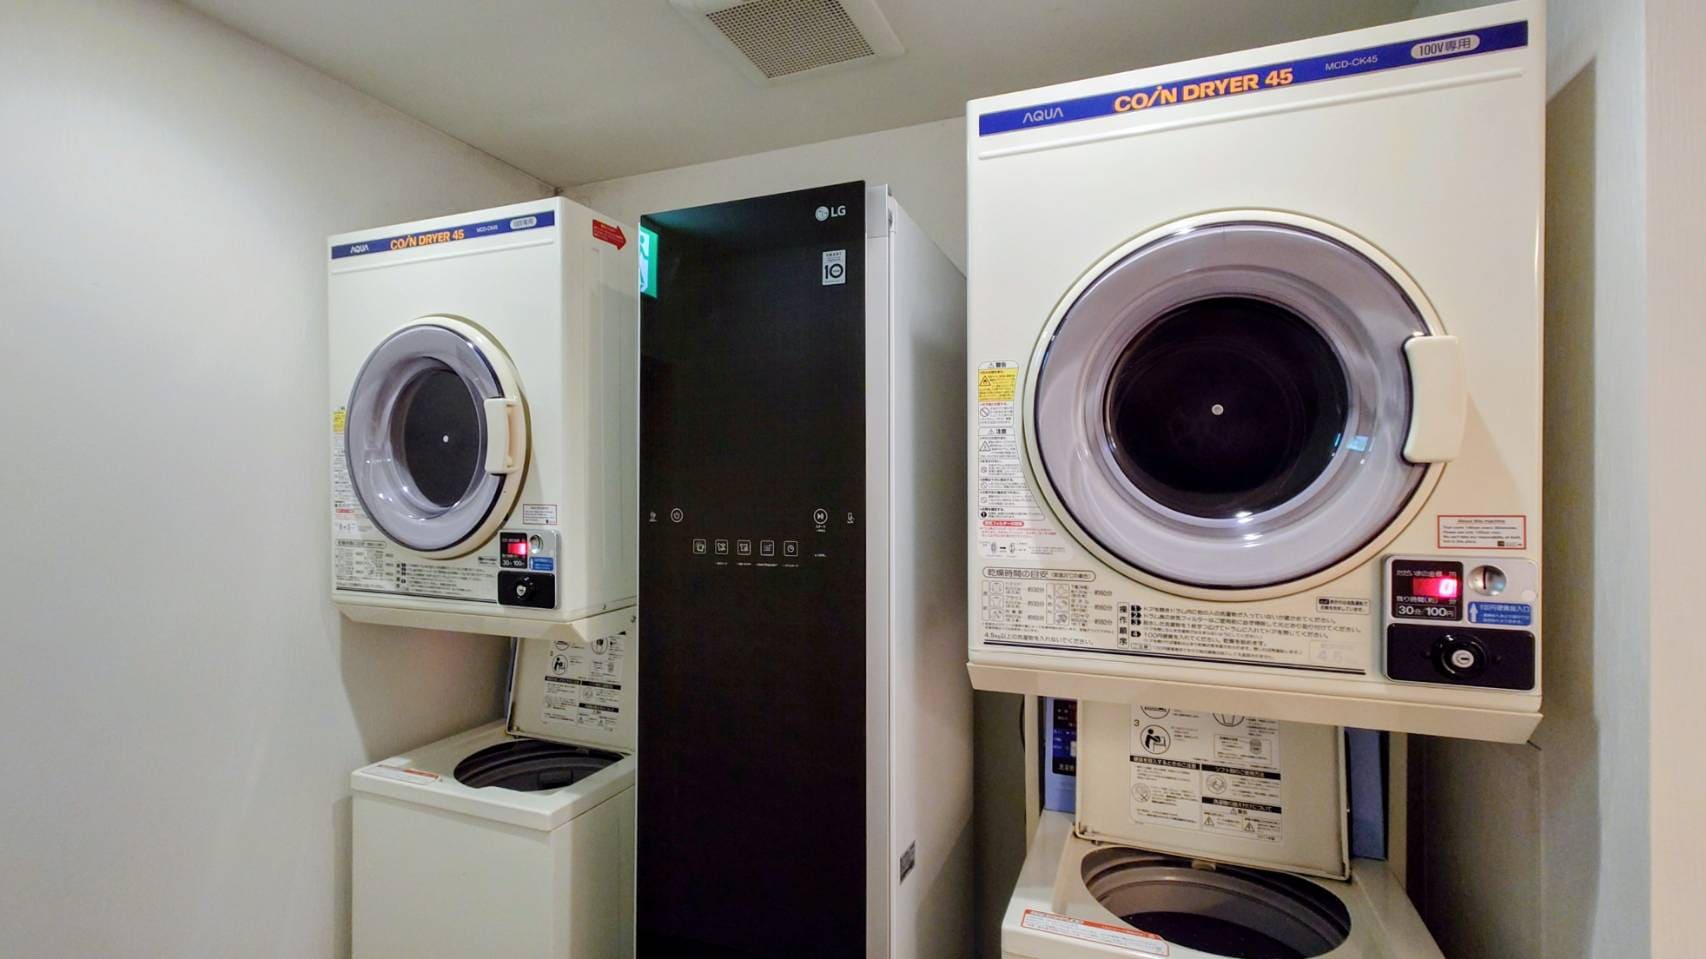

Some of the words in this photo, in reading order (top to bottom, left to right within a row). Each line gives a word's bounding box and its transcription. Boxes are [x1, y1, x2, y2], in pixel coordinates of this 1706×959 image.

[1417, 36, 1473, 58] 100V専用
[1325, 55, 1378, 72] MCD-CK45
[1182, 73, 1260, 102] DRYER
[1265, 68, 1294, 86] 45
[1022, 108, 1064, 123] AQUA
[831, 205, 846, 217] LG
[418, 230, 451, 247] DRYER
[452, 229, 465, 241] 45
[350, 243, 369, 254] AQUA
[824, 263, 844, 280] 10
[987, 569, 1048, 579] 乾燥時間の目安
[1133, 719, 1140, 727] 3
